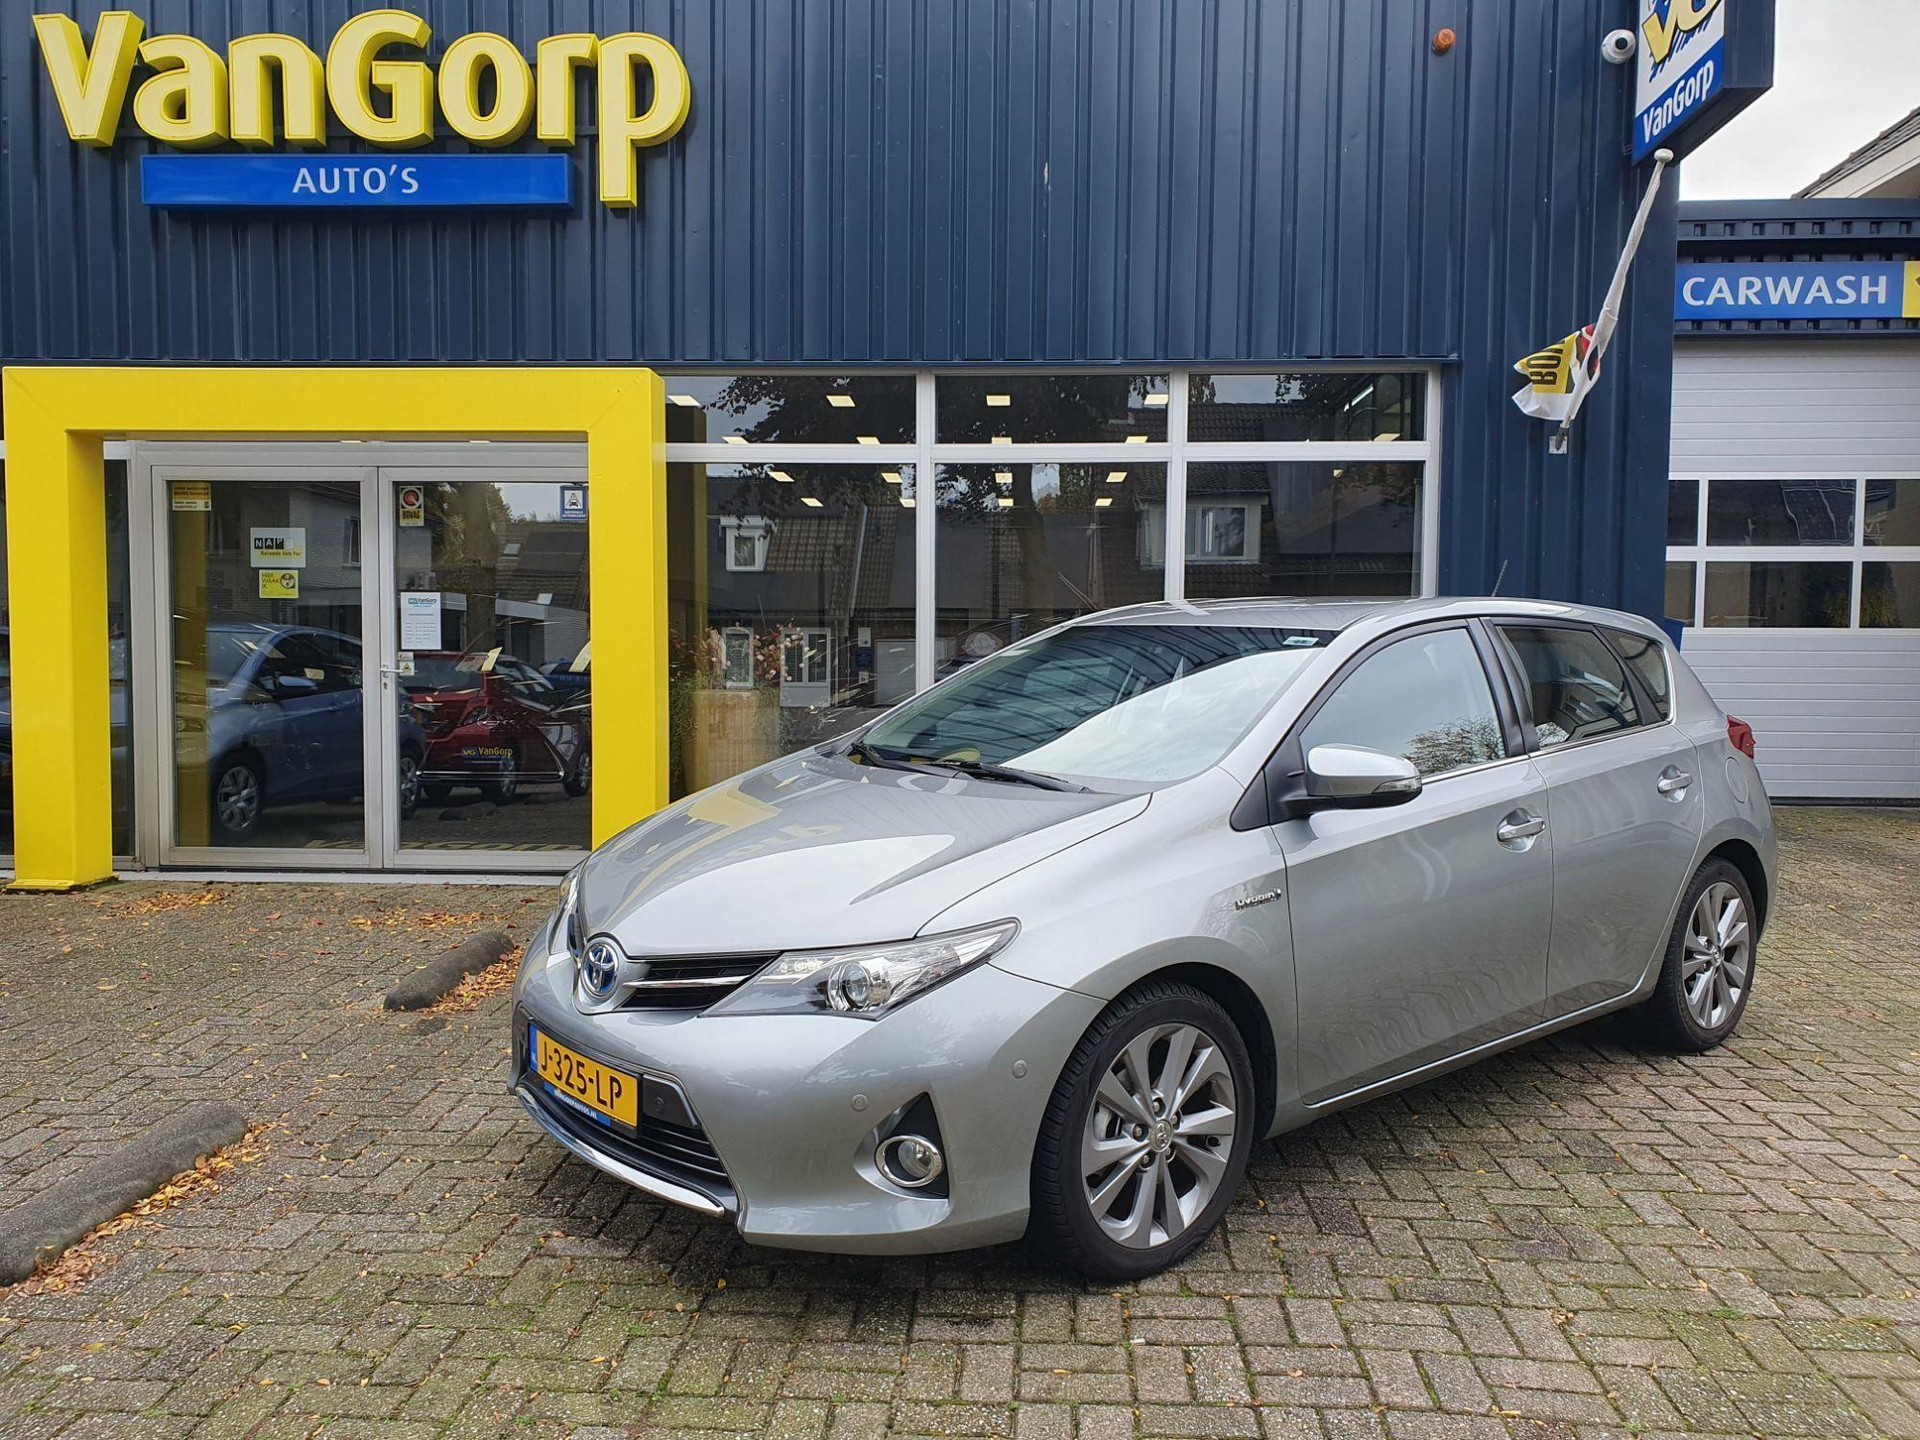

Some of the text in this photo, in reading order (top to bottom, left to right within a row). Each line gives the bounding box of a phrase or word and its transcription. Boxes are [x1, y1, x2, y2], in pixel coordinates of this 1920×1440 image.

[32, 9, 692, 208] VanGorp
[1643, 60, 1714, 143] VanGorp
[292, 164, 419, 194] AUTO'S
[1682, 275, 1887, 306] CARWASH
[478, 747, 513, 758] VanGorp
[540, 1040, 623, 1111] J-325-LP
